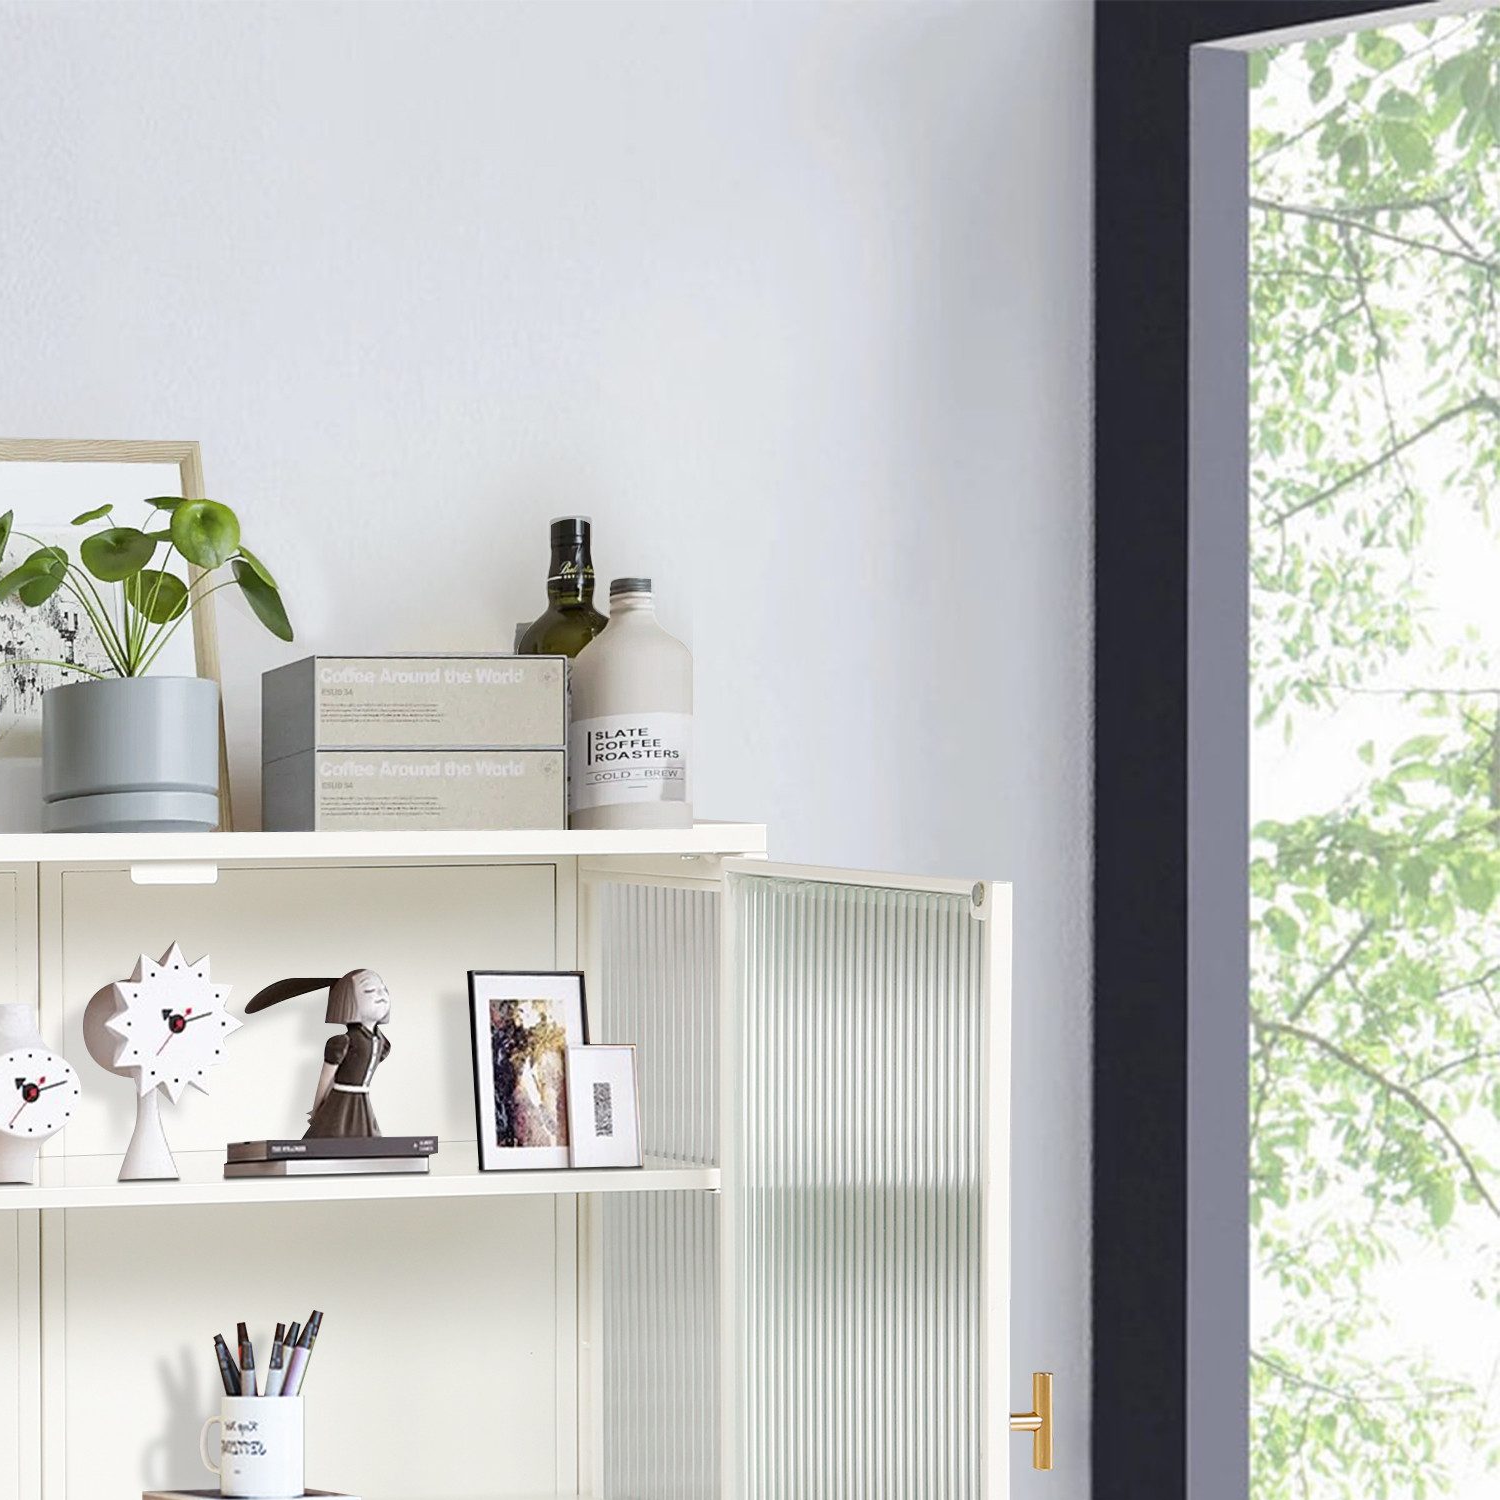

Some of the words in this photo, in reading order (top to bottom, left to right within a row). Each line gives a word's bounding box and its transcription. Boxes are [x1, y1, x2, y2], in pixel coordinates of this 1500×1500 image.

[320, 667, 375, 684] Coffee
[380, 667, 440, 684] Around
[445, 667, 471, 684] the
[475, 667, 523, 684] World
[595, 728, 649, 741] SLATE
[595, 739, 662, 752] COFFEE
[595, 750, 680, 763] ROASTERS
[320, 760, 375, 777] Coffee
[380, 760, 441, 777] Around
[445, 760, 472, 778] the
[475, 760, 525, 777] World
[594, 771, 631, 782] COLD
[644, 769, 678, 778] BREW
